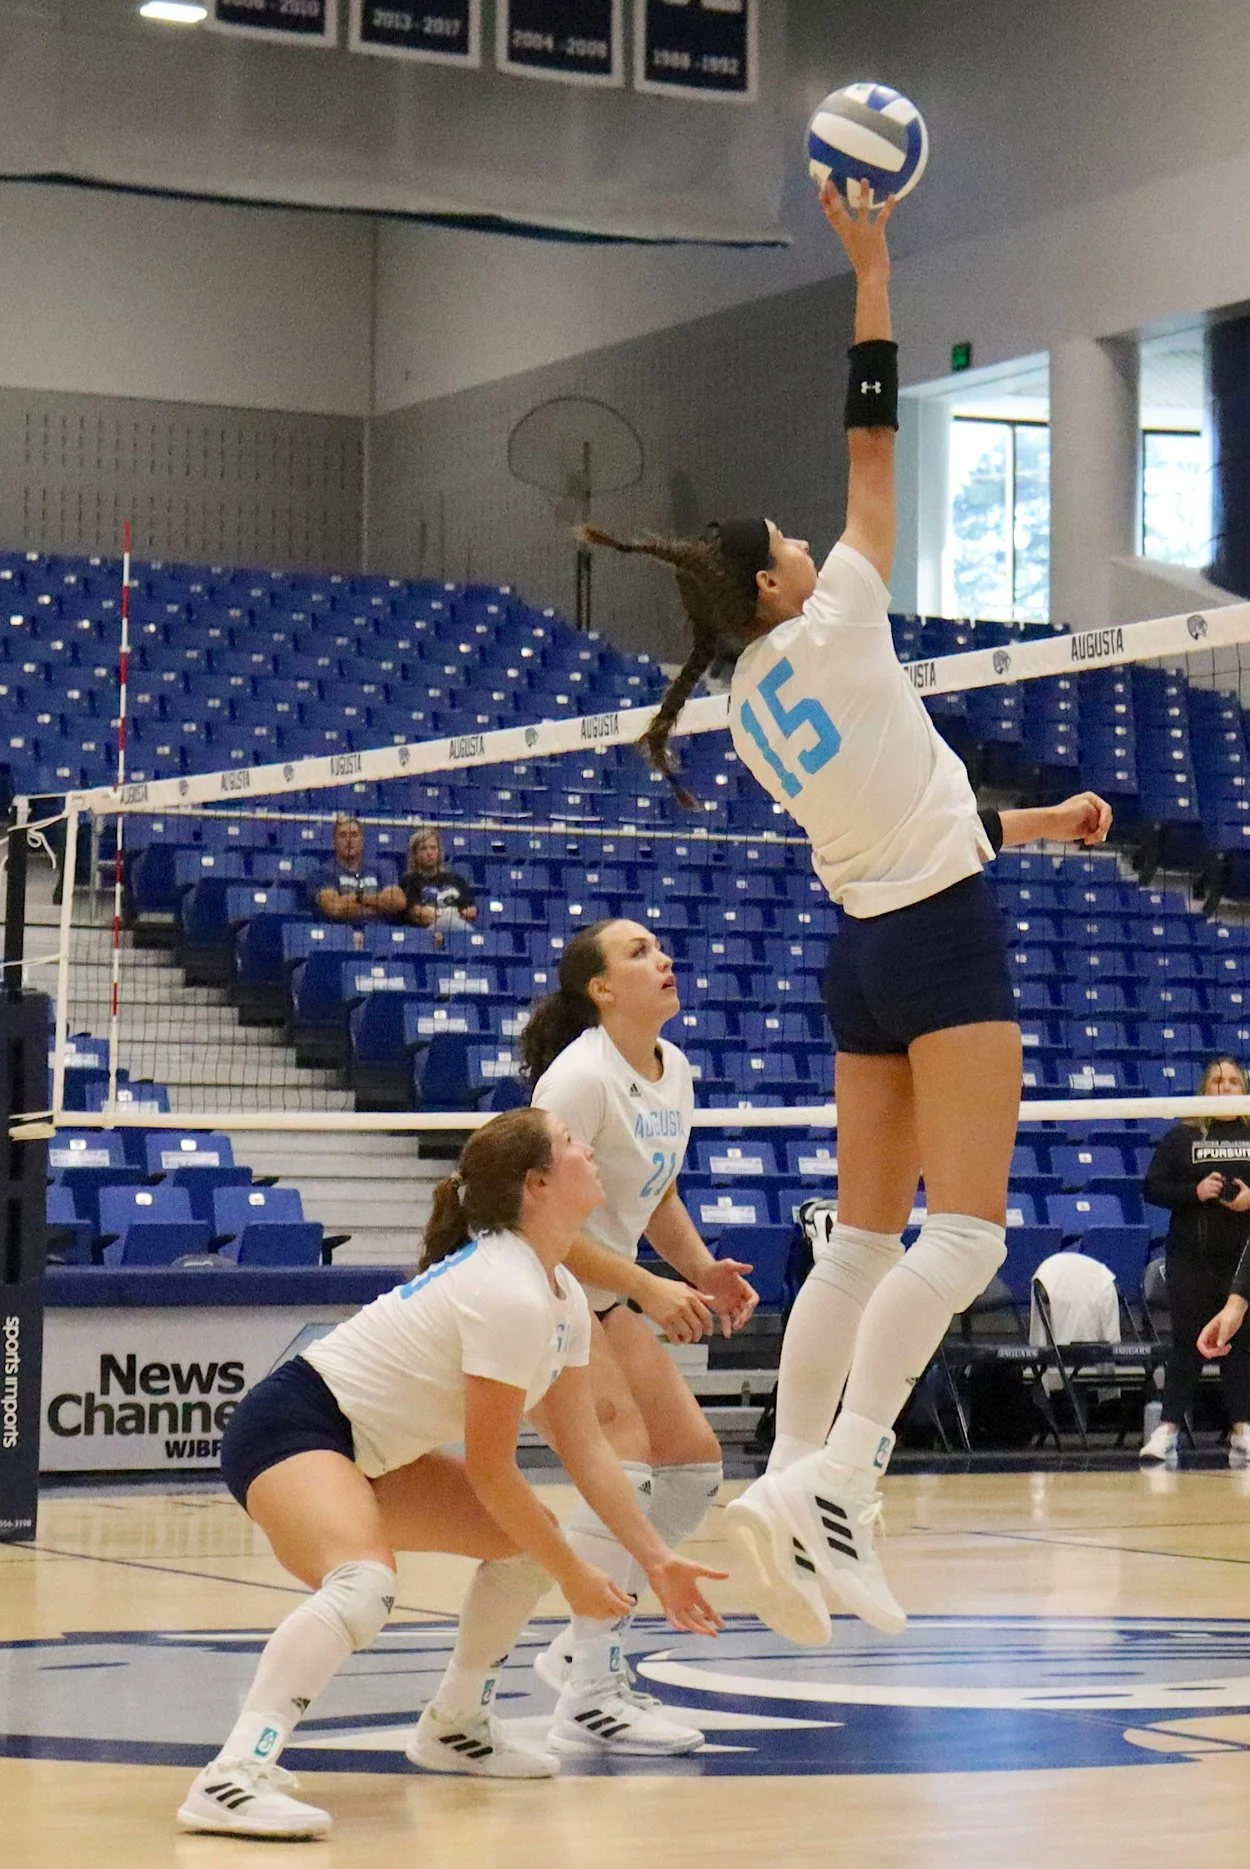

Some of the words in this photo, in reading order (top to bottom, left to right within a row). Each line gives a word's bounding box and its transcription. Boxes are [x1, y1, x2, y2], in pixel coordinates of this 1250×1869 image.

[1071, 628, 1124, 662] AUGUSTA
[449, 735, 485, 760] AUGUSTA
[581, 714, 619, 739] AUGUSTA
[740, 655, 842, 799] 15
[640, 1152, 677, 1197] 21
[4, 1316, 20, 1374] sports
[100, 1354, 245, 1396] News
[3, 1376, 19, 1449] imports
[47, 1391, 239, 1437] Channe
